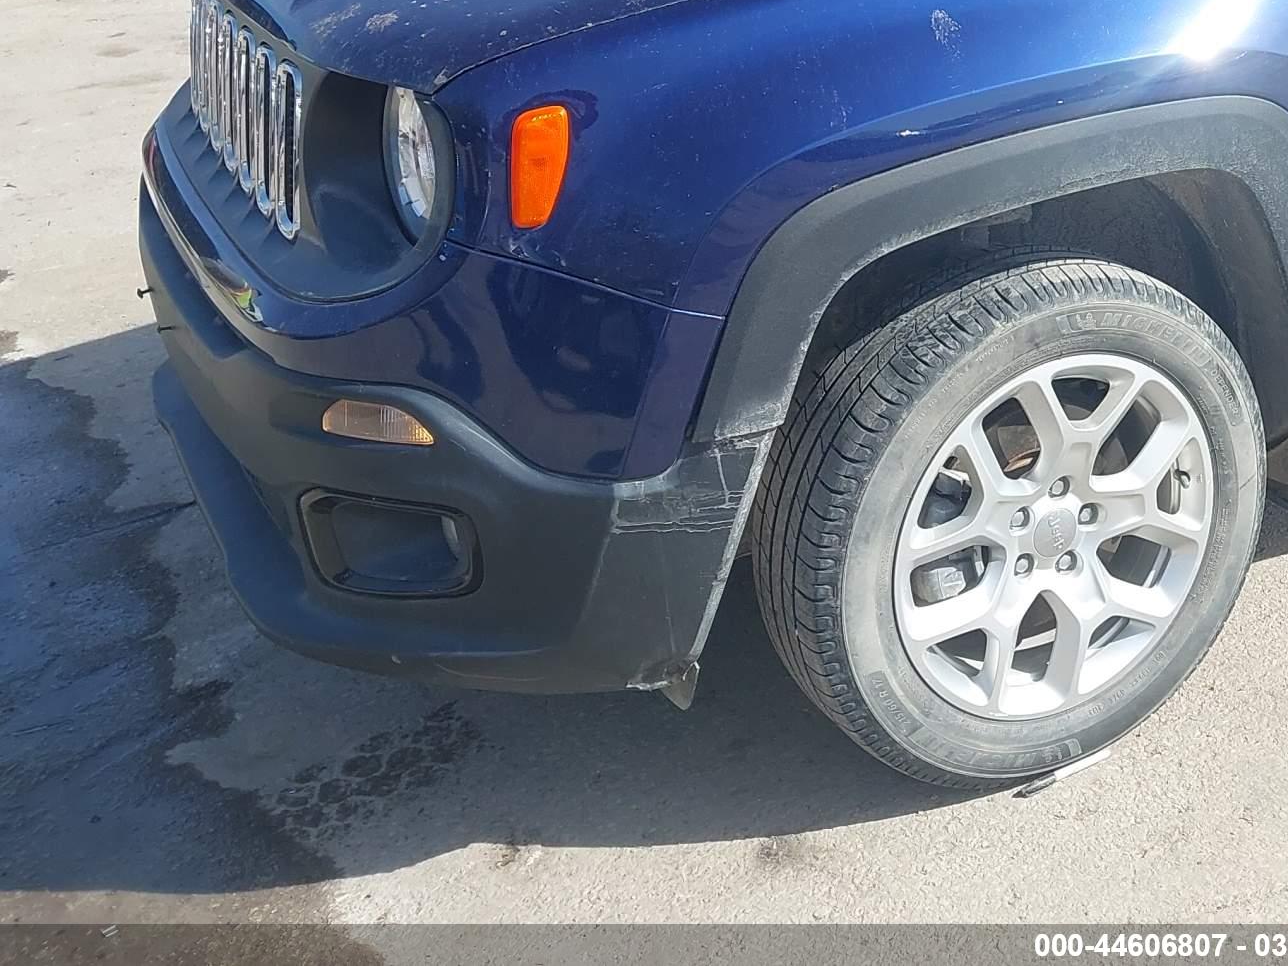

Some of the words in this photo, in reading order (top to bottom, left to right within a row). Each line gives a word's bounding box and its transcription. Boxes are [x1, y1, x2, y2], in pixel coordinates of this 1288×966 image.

[1100, 312, 1212, 368] MICHELIN
[1210, 367, 1241, 416] DEFENDER
[1046, 514, 1066, 551] Jeep
